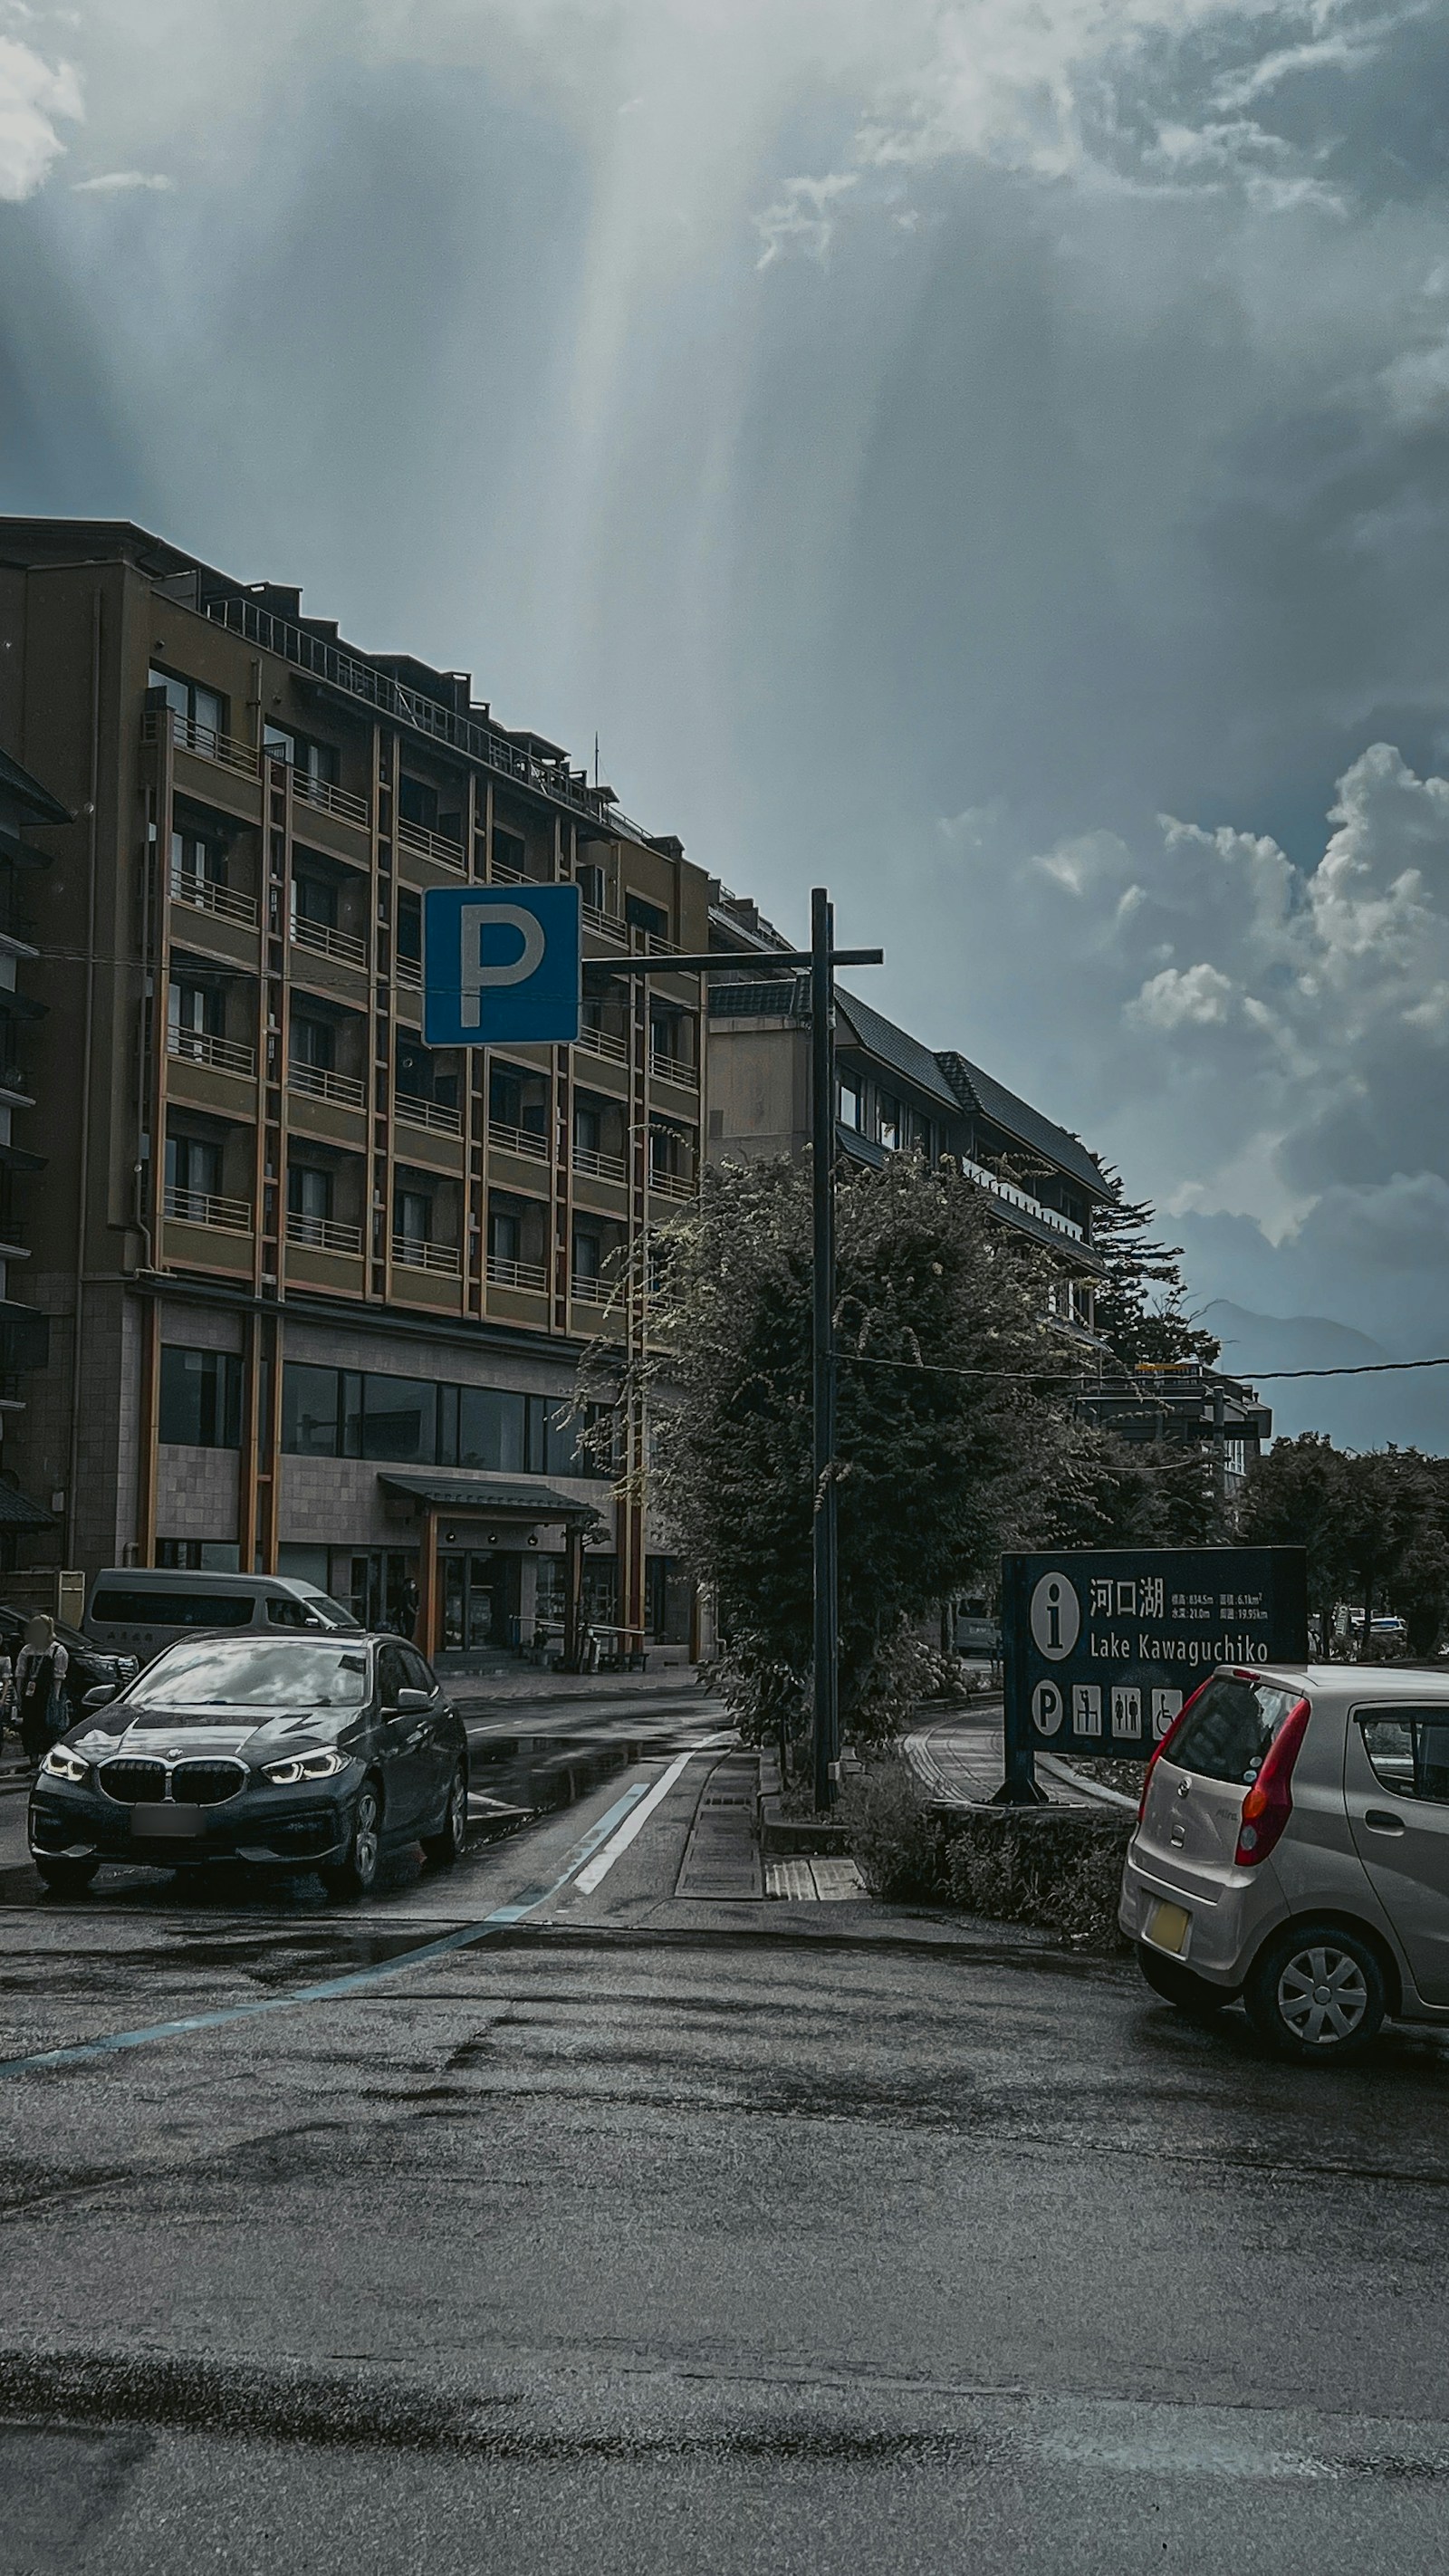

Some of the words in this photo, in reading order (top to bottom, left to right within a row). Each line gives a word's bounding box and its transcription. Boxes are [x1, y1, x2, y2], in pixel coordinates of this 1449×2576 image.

[461, 904, 545, 1028] P
[1047, 1583, 1063, 1648] i
[1089, 1577, 1164, 1619] 河口湖
[1091, 1631, 1130, 1658] Lake
[1139, 1633, 1268, 1667] Kawaguchiko
[1040, 1689, 1057, 1726] P
